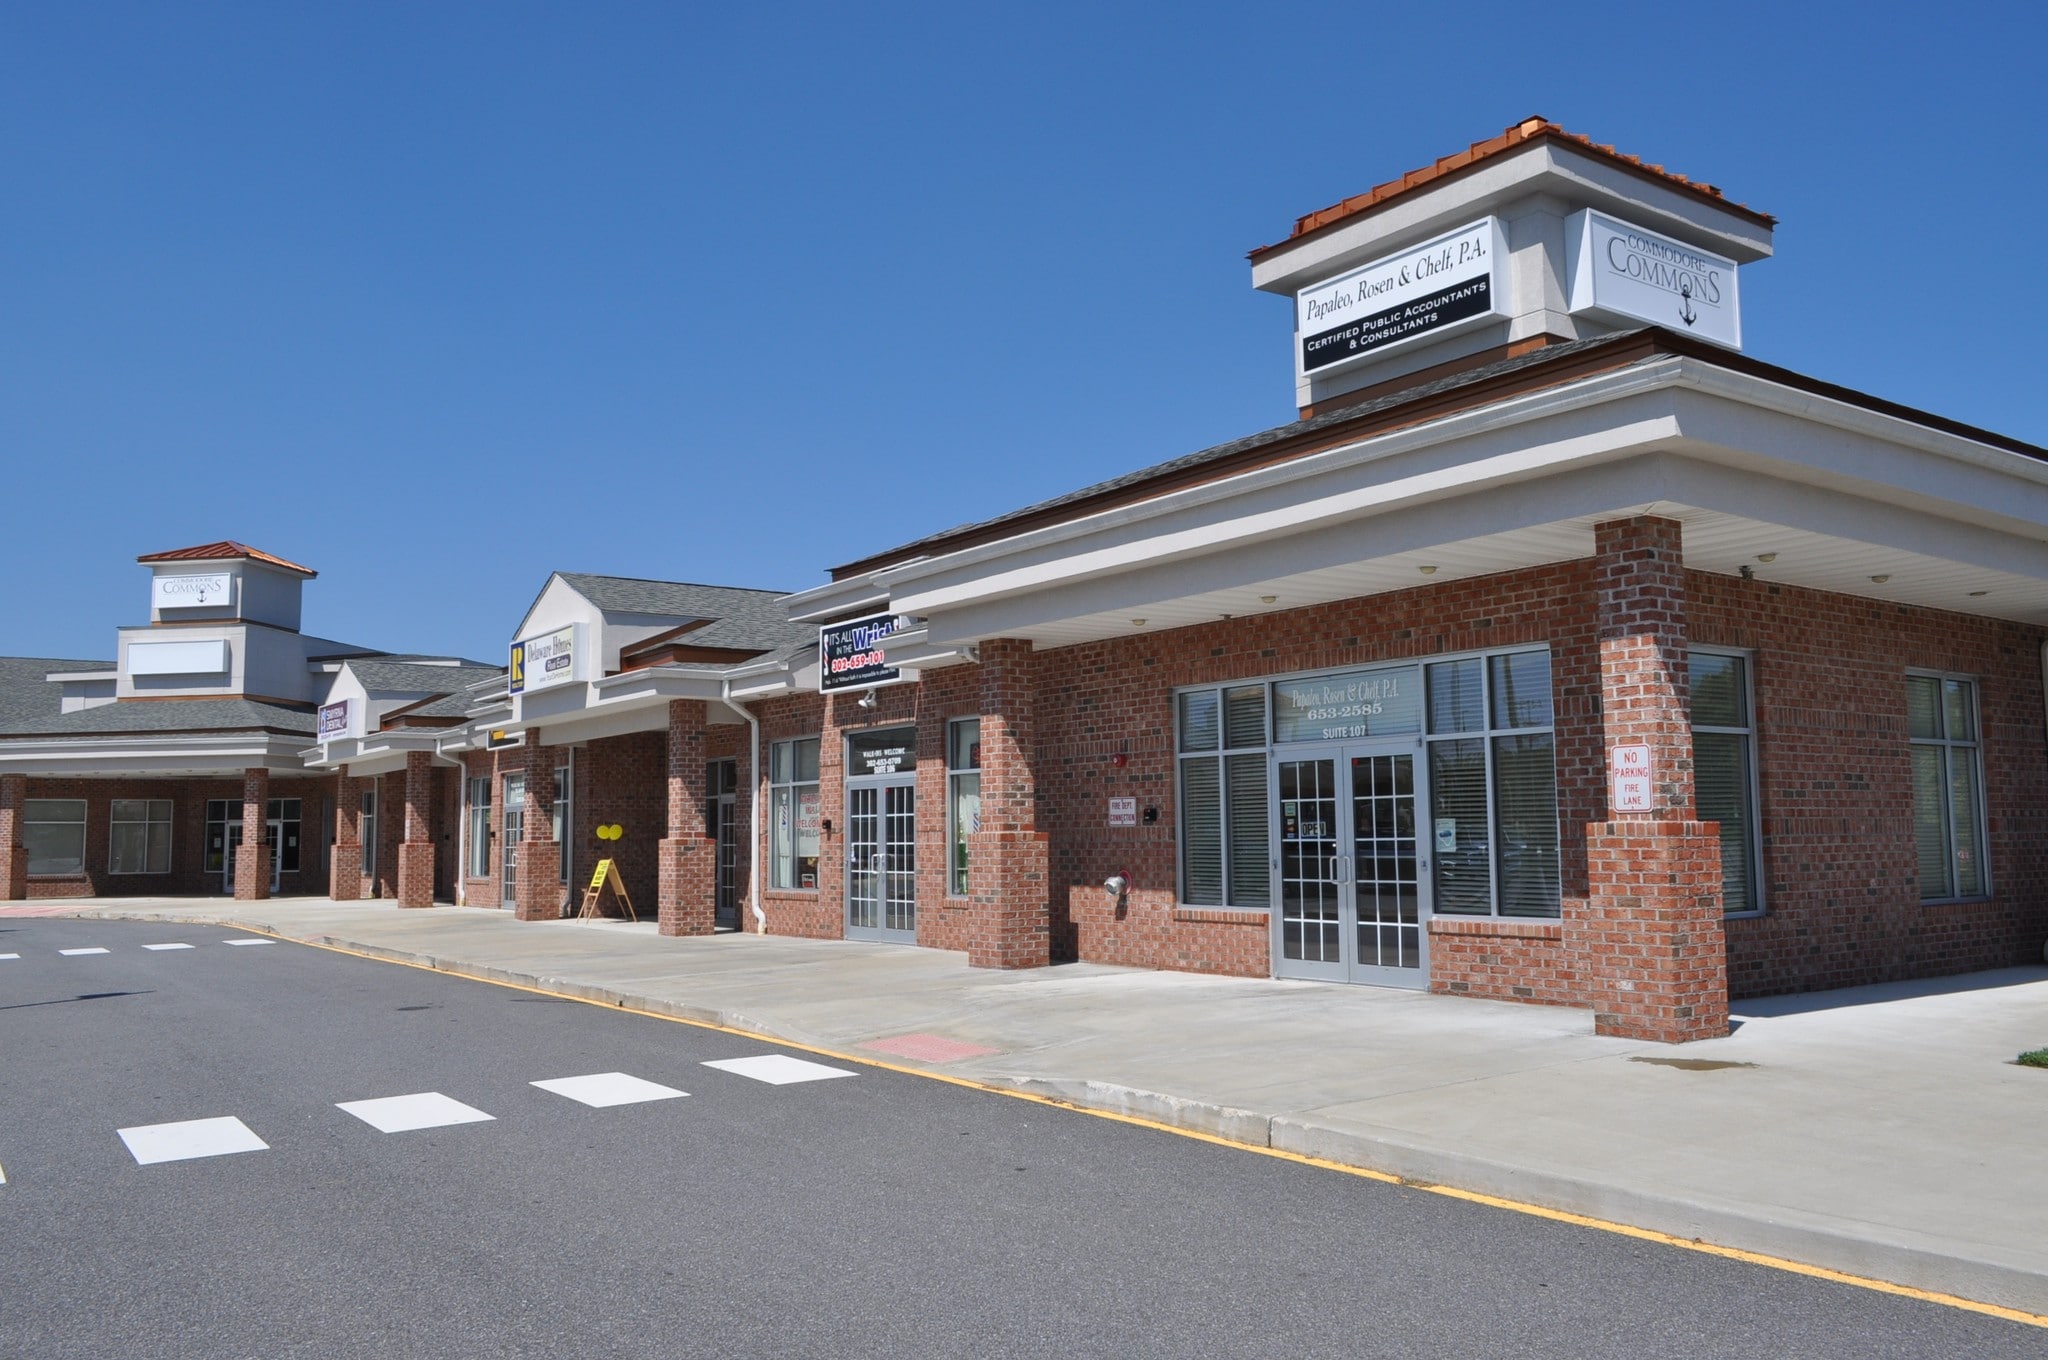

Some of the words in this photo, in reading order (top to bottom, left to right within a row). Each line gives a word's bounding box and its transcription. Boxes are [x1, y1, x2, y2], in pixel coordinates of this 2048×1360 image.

[1627, 234, 1707, 273] COMMODORE
[1606, 236, 1721, 304] COMMONS
[1306, 290, 1354, 321] Papaleo,
[1357, 279, 1394, 303] Rosen
[1399, 265, 1411, 287] &
[1415, 246, 1455, 281] Chelf,
[1458, 237, 1487, 265] P.A.
[1307, 326, 1360, 352] CERTIFIED
[1362, 311, 1401, 332] PUBLIC
[1404, 281, 1487, 318] ACCOUNTANTS
[1349, 339, 1357, 350] &
[1360, 312, 1438, 346] CONSULTANTS
[162, 579, 222, 594] COMMONS
[829, 632, 840, 646] IT'S
[841, 630, 852, 643] ALL
[528, 642, 552, 662] Delaware
[553, 636, 572, 655] Homes
[836, 647, 842, 655] IN
[843, 644, 852, 654] THE
[1323, 686, 1345, 705] Rosen
[1347, 682, 1357, 701] &
[1382, 678, 1400, 699] P.A.
[1307, 702, 1383, 721] 653-2585
[1322, 727, 1348, 739] SUITE
[1349, 725, 1367, 737] 107
[1624, 751, 1638, 764] NO
[1615, 767, 1649, 778] PARKING
[1624, 783, 1640, 793] FIRE
[1623, 796, 1642, 805] LANE
[1303, 823, 1325, 835] OPEN
